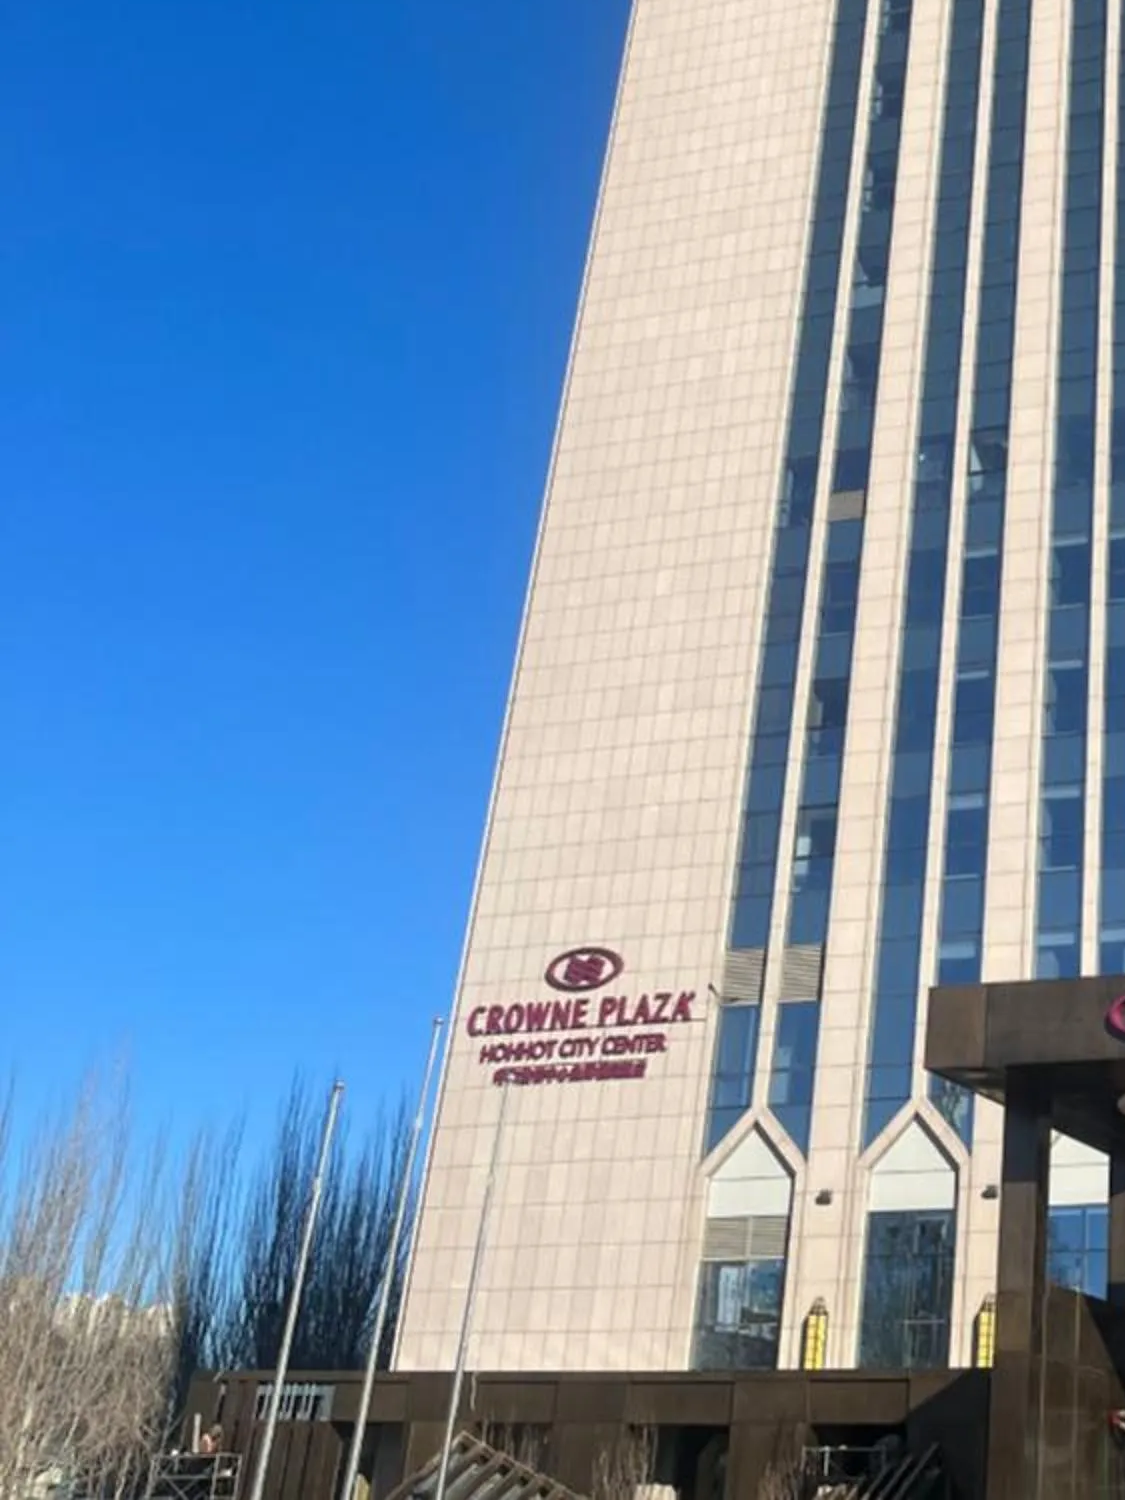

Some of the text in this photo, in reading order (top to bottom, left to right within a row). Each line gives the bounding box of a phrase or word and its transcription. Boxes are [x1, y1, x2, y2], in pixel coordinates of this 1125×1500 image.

[467, 990, 695, 1036] CROWNE PLAZA
[480, 1032, 667, 1064] HOHHOT CITY CENTER
